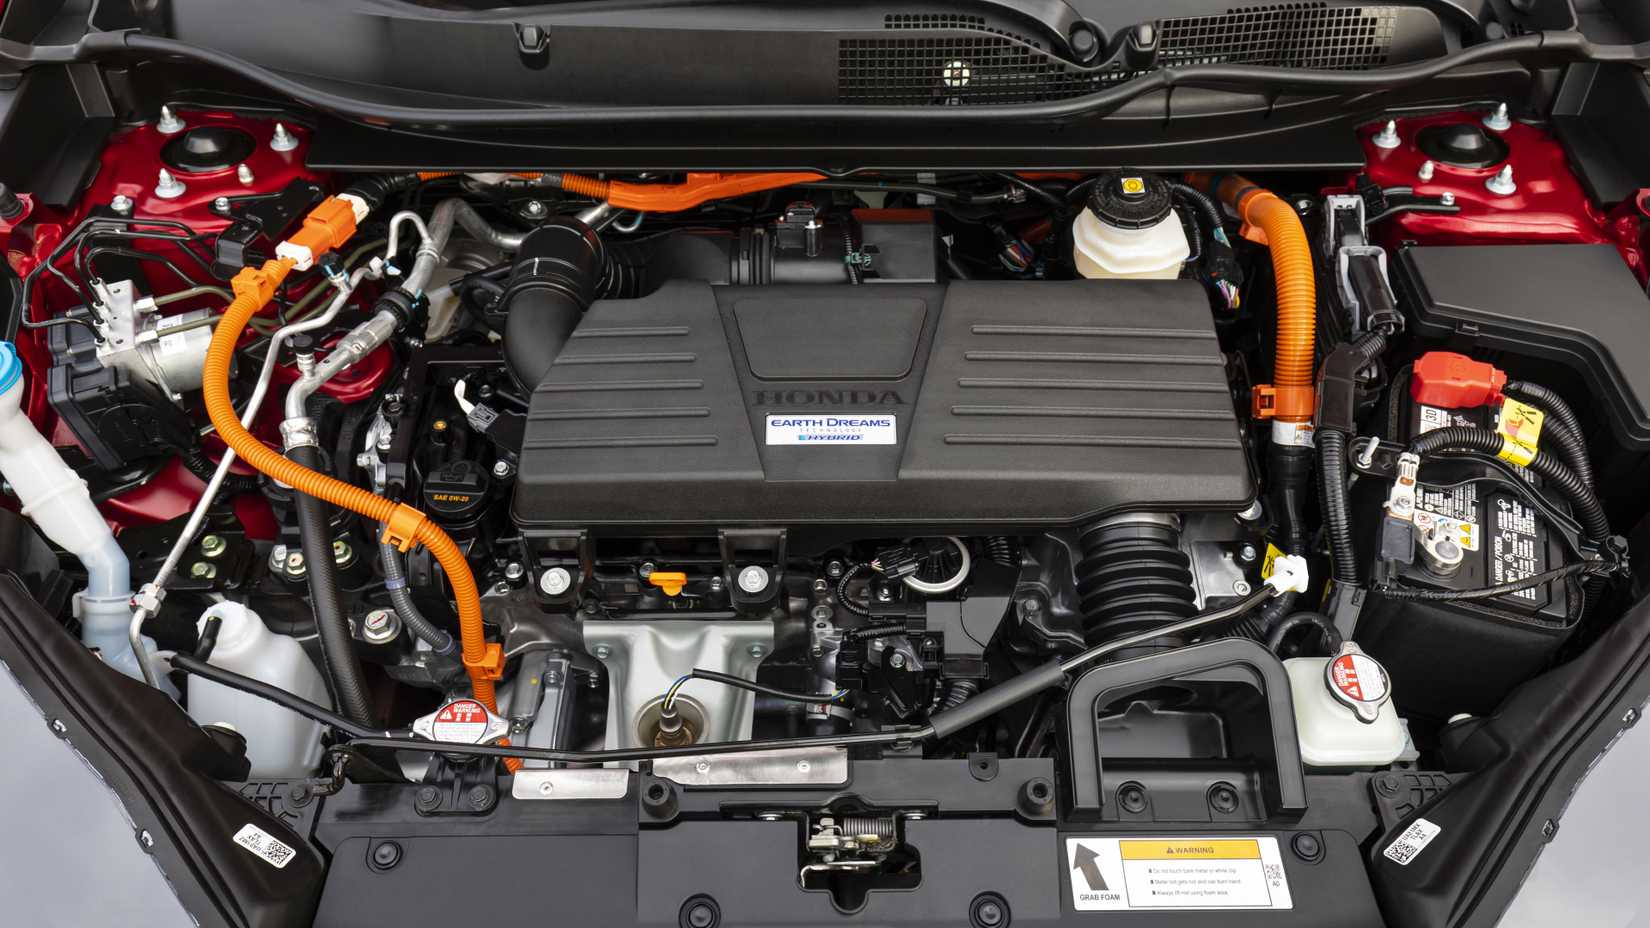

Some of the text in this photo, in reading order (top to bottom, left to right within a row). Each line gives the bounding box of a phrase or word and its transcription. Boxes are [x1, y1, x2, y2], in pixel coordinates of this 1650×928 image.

[752, 390, 905, 405] HONDA
[771, 418, 891, 427] EARTH DREAMS
